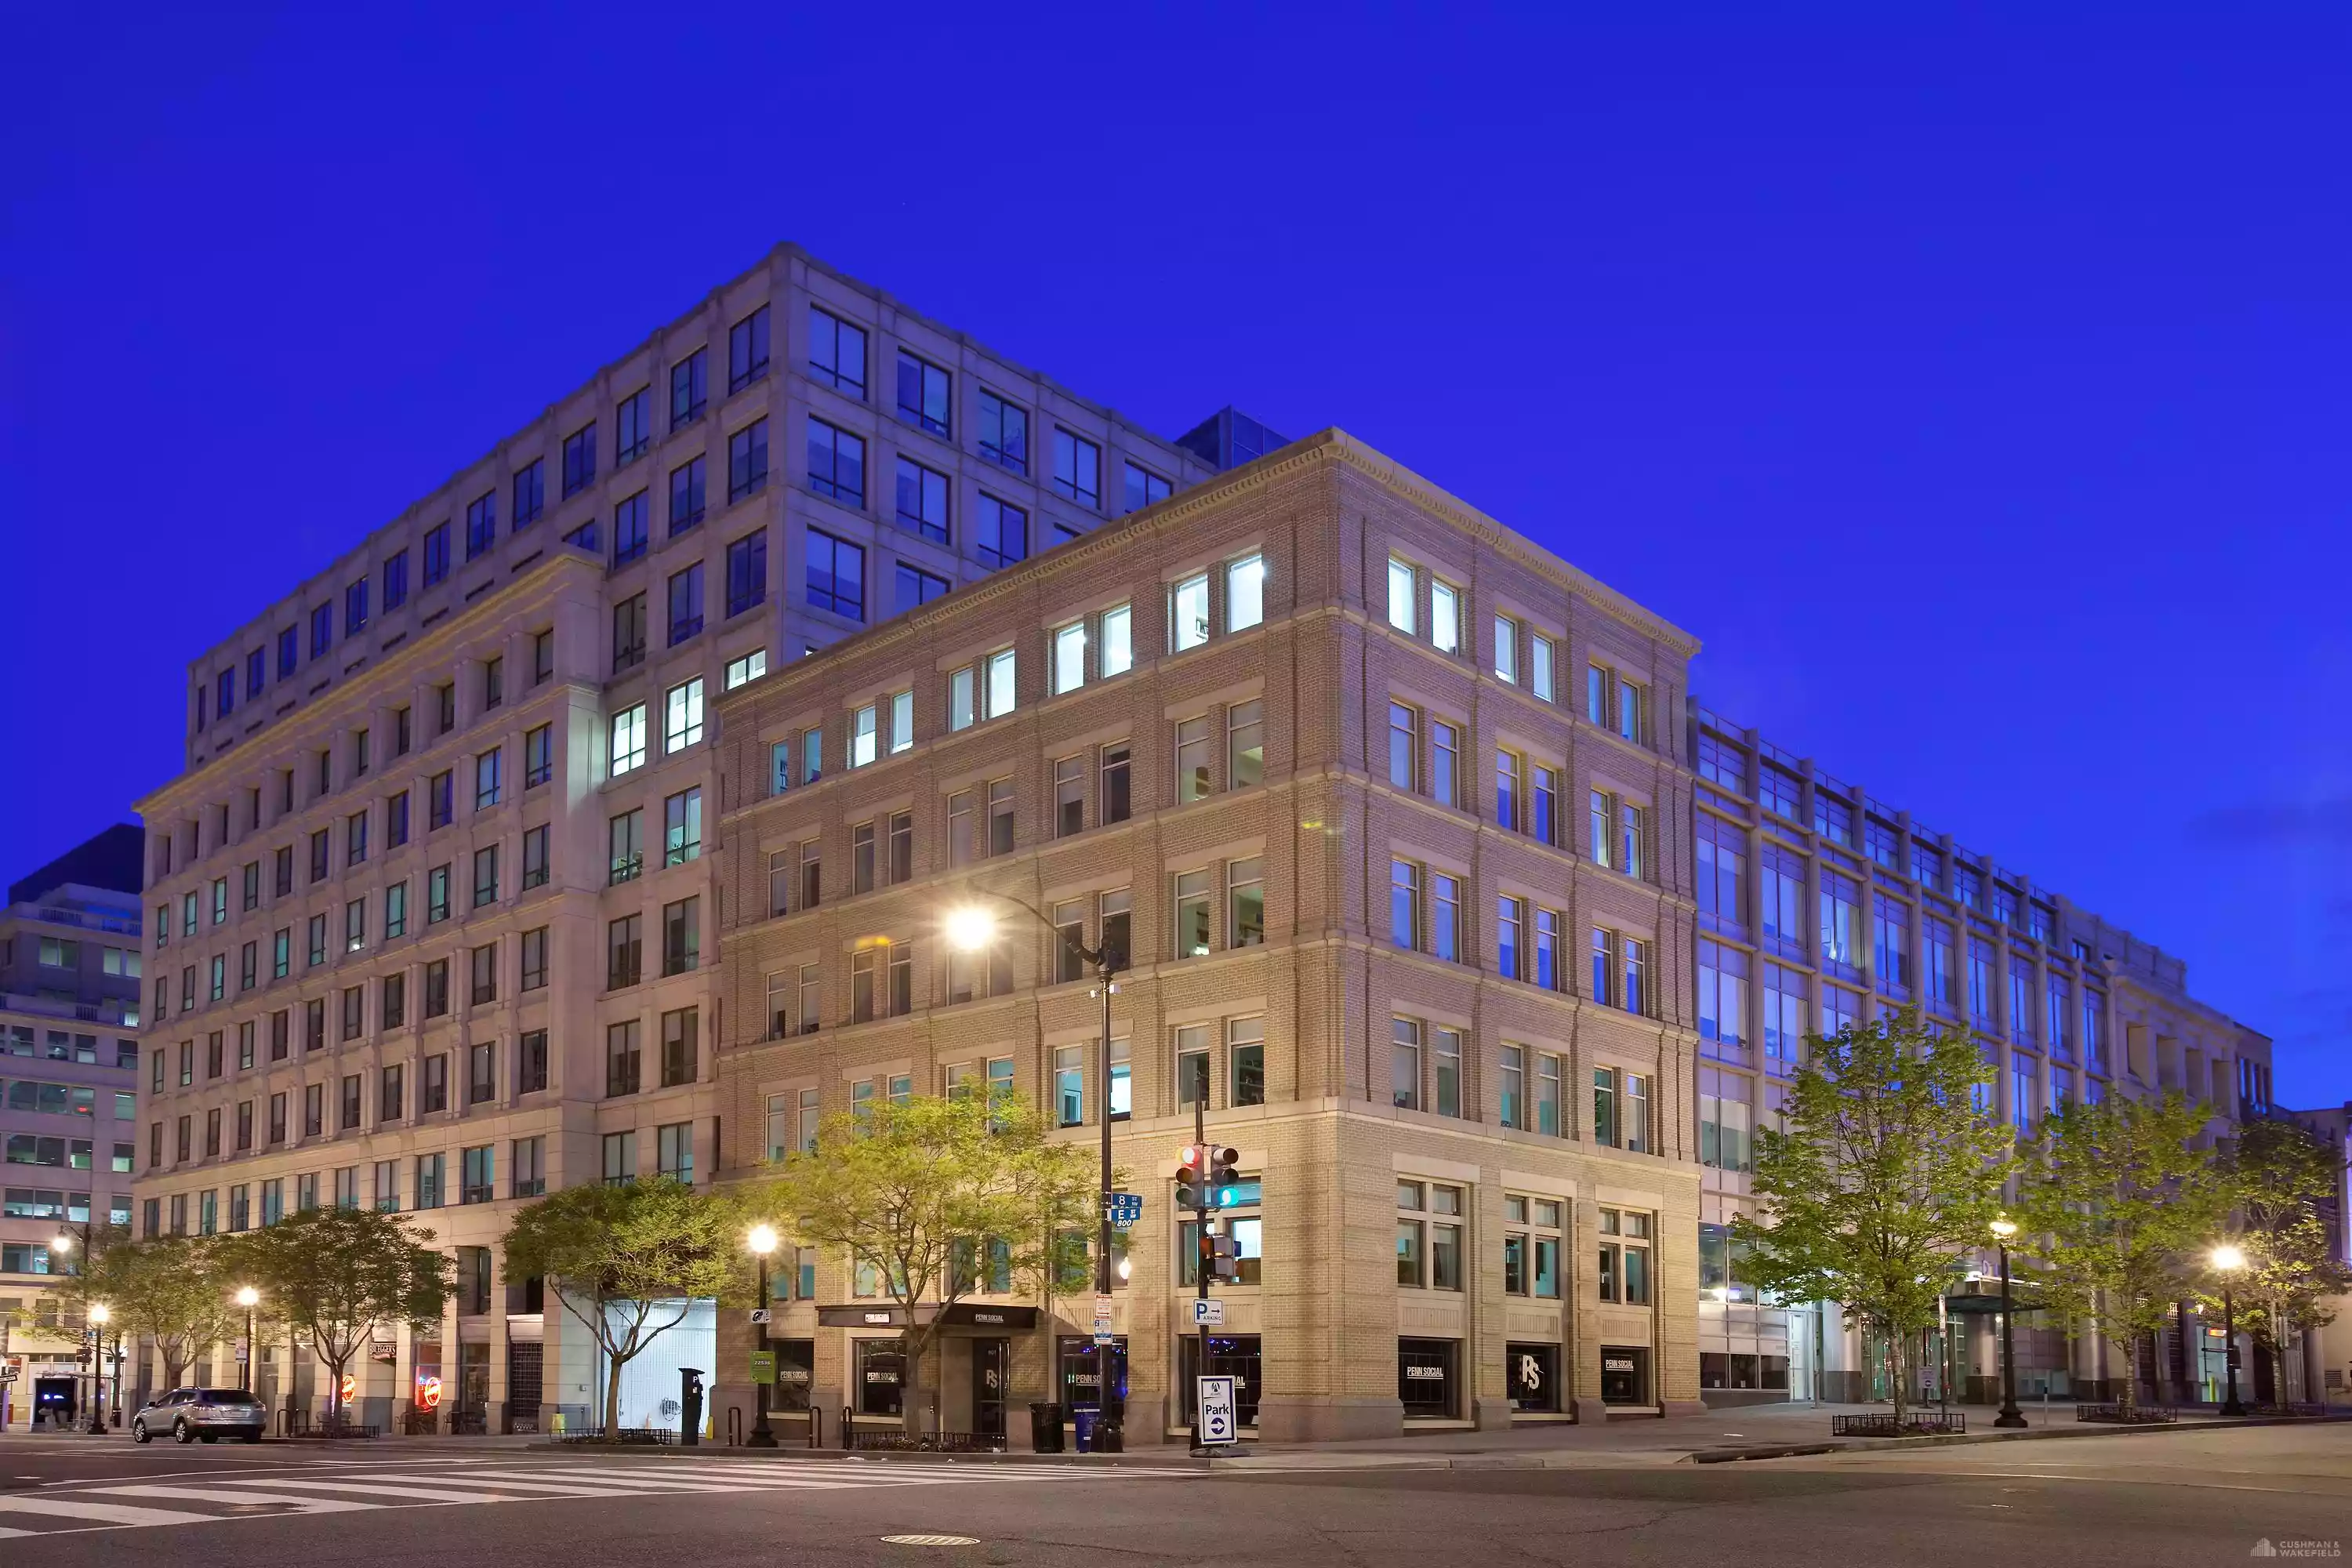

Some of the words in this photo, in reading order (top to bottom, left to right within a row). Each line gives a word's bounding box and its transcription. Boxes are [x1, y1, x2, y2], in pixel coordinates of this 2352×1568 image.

[1119, 1196, 1126, 1205] 8
[1118, 1210, 1125, 1220] E
[1618, 1360, 1634, 1369] SOCIAL
[881, 1372, 898, 1381] SOCIAL
[1407, 1367, 1423, 1377] PENN
[1423, 1367, 1443, 1377] SOCIAL
[1076, 1374, 1092, 1383] PENN
[1206, 1404, 1229, 1415] Park
